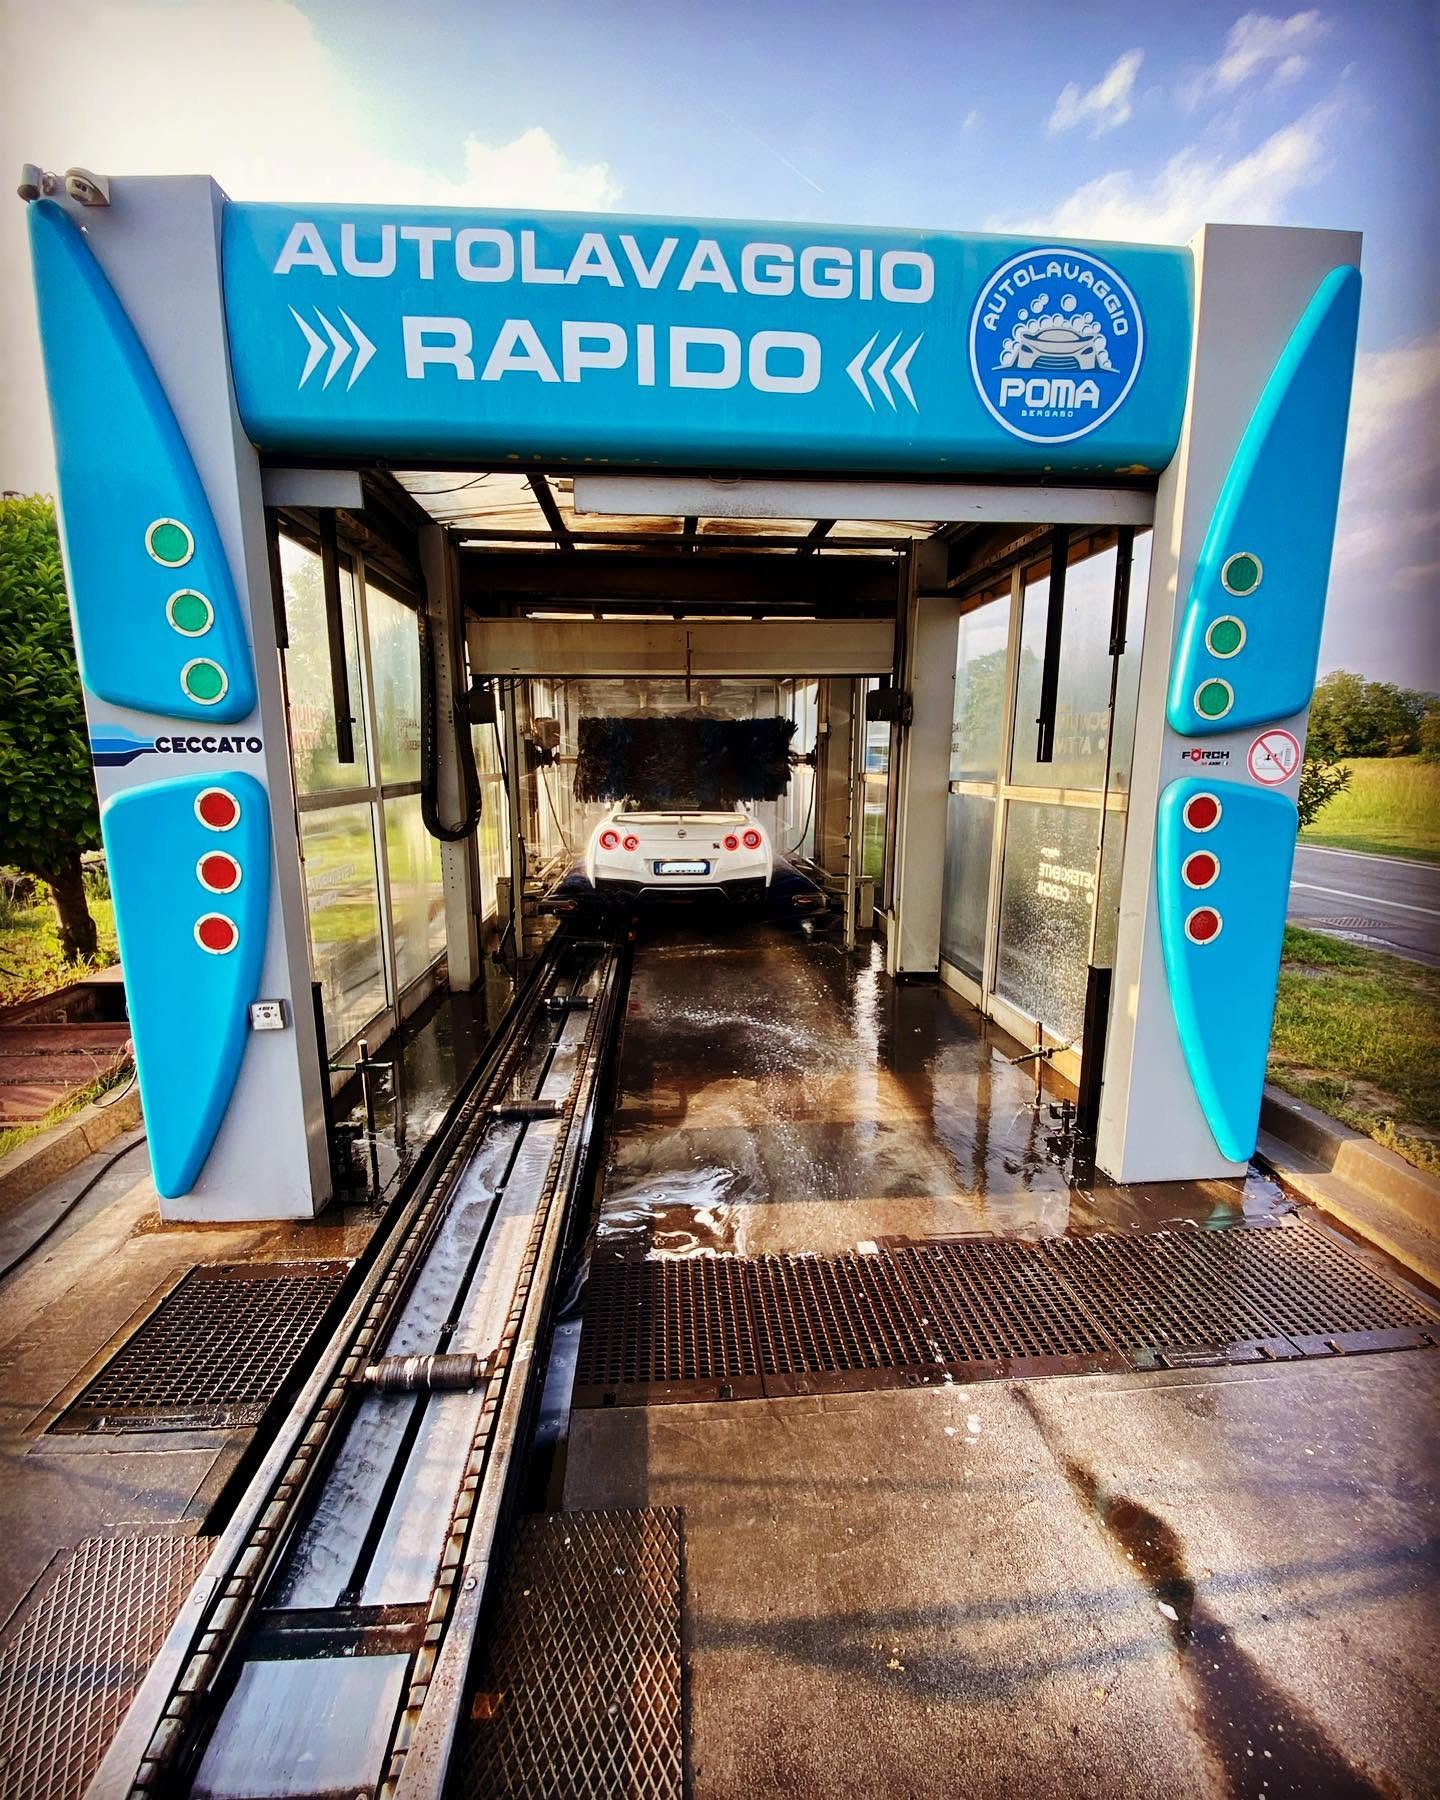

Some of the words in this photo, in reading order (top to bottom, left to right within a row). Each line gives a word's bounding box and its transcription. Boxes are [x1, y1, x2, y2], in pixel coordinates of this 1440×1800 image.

[273, 222, 936, 304] AUTOLAVAGGIO
[983, 262, 1128, 336] AUTOLAVAGGIO
[402, 315, 822, 394] RAPIDO
[999, 377, 1100, 409] POMA
[156, 737, 263, 753] CECCATO
